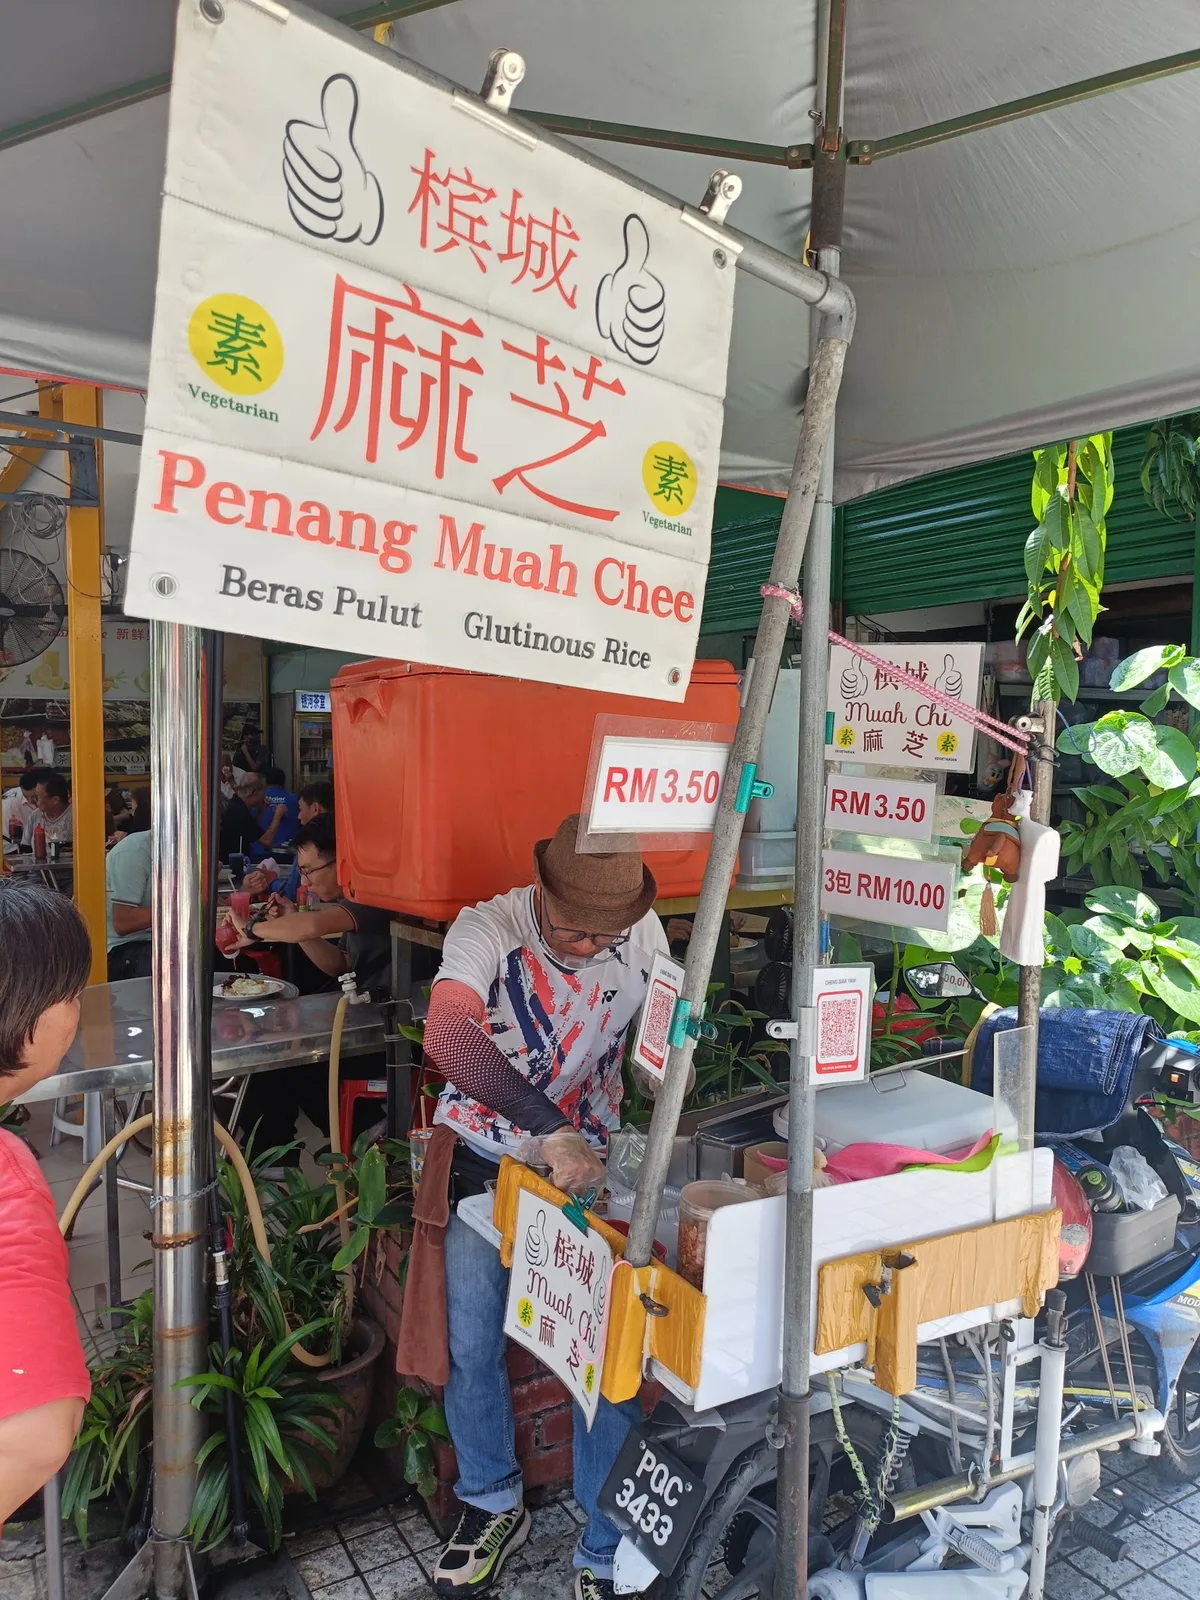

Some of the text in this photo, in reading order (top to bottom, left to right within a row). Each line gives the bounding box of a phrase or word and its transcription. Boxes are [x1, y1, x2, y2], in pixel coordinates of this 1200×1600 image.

[407, 147, 582, 310] 槟城
[206, 308, 269, 382] 素
[188, 383, 280, 423] Vegetarian
[310, 273, 627, 522] 麻芝
[651, 454, 689, 506] 素
[152, 450, 695, 624] Penang Muah Chee
[641, 510, 692, 536] Vegetarian
[219, 565, 652, 670] Beras Pulut Glutinous Rice
[839, 728, 854, 745] 素
[845, 702, 952, 727] Muah Chi
[940, 734, 956, 752] 素
[104, 754, 150, 764] CONOM
[553, 1228, 595, 1294] 槟城
[526, 1268, 597, 1353] Muah Chi
[636, 1447, 684, 1507] PQC
[615, 1478, 673, 1546] 3433
